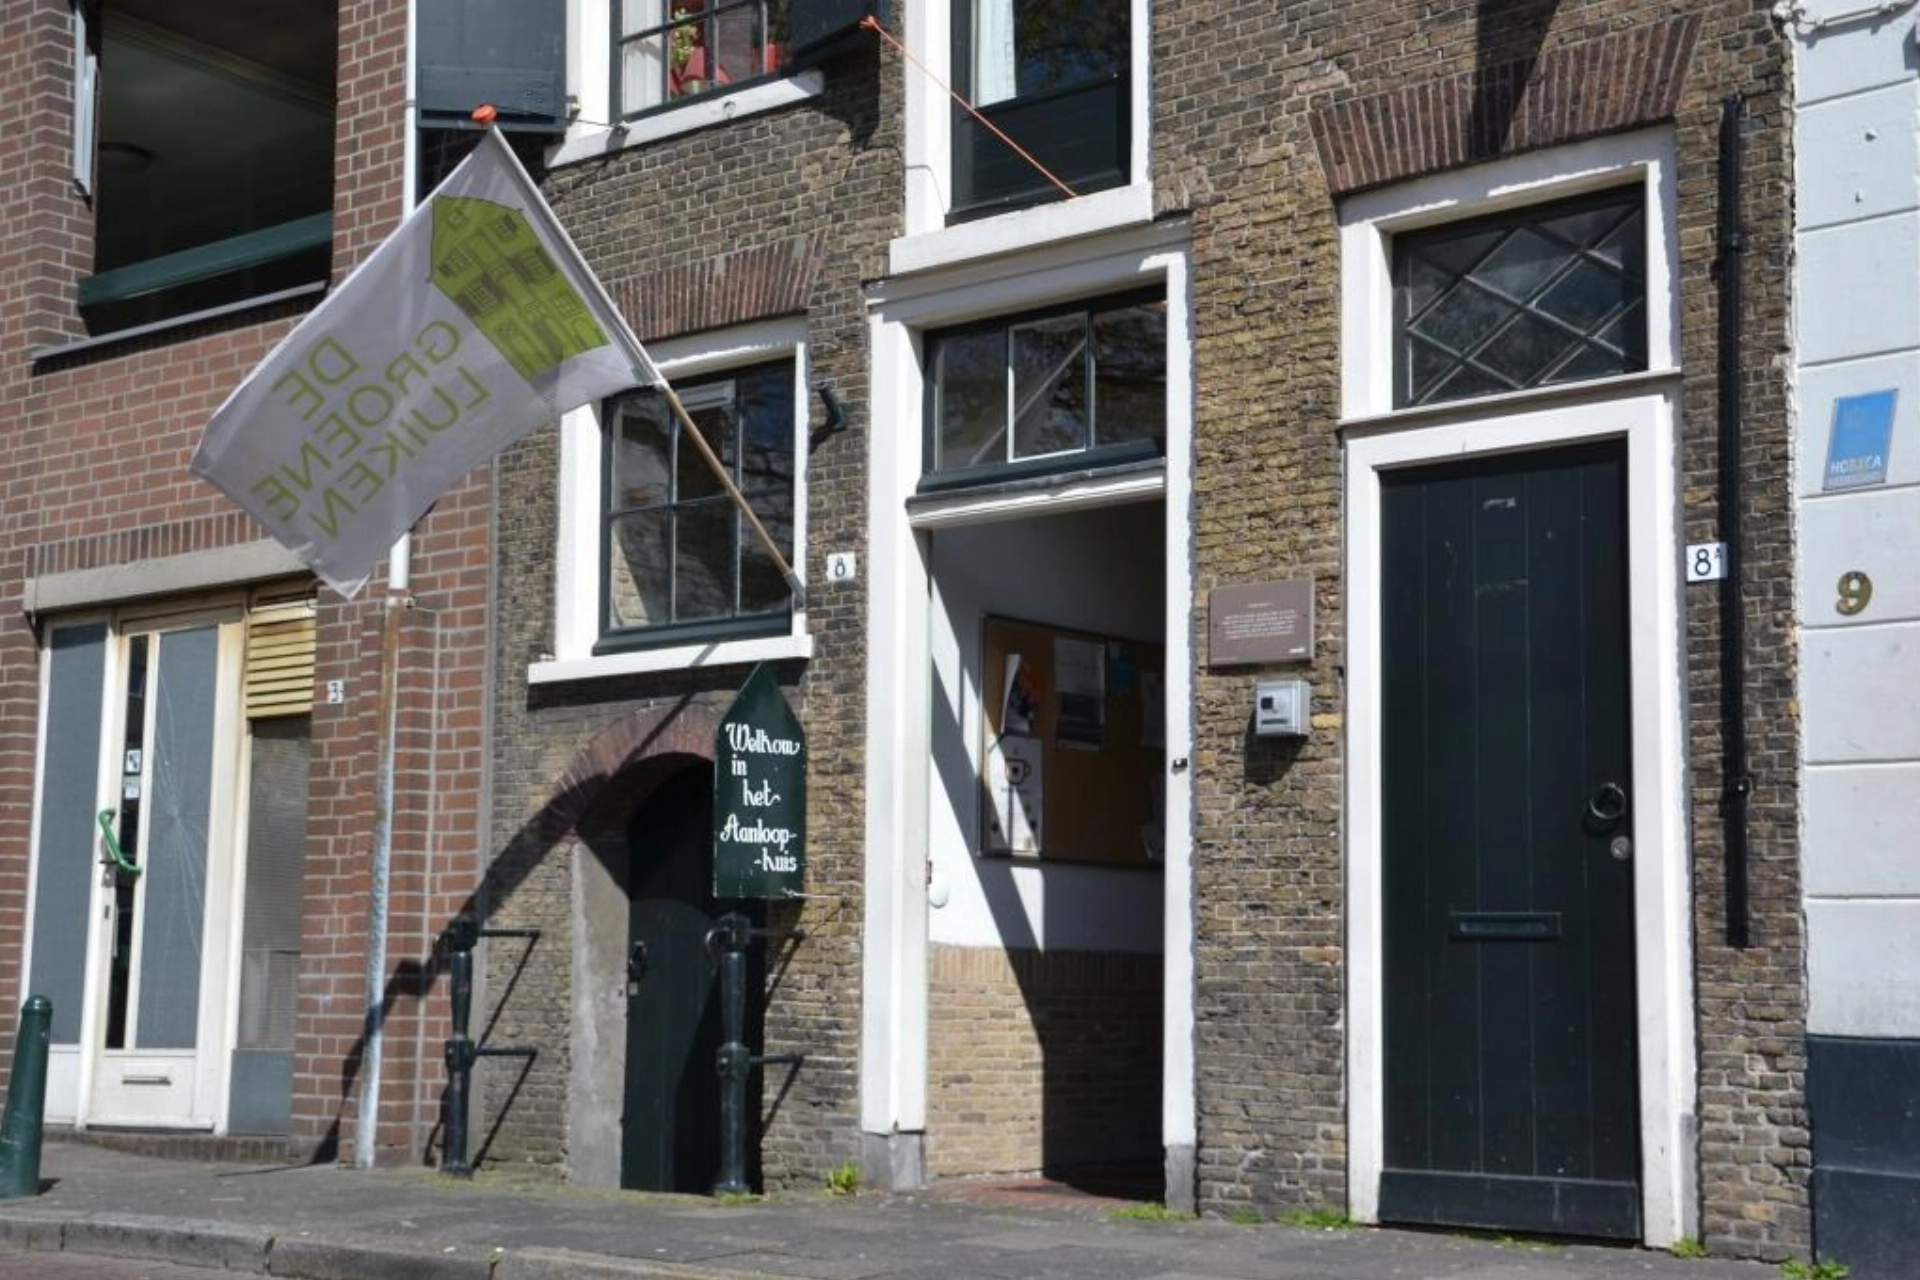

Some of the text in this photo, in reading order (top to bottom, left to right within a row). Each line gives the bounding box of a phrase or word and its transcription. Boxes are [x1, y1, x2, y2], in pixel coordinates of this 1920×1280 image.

[834, 556, 846, 578] 8
[1835, 570, 1873, 616] 9
[725, 722, 800, 755] Welkom
[731, 753, 748, 776] in
[743, 779, 781, 806] het
